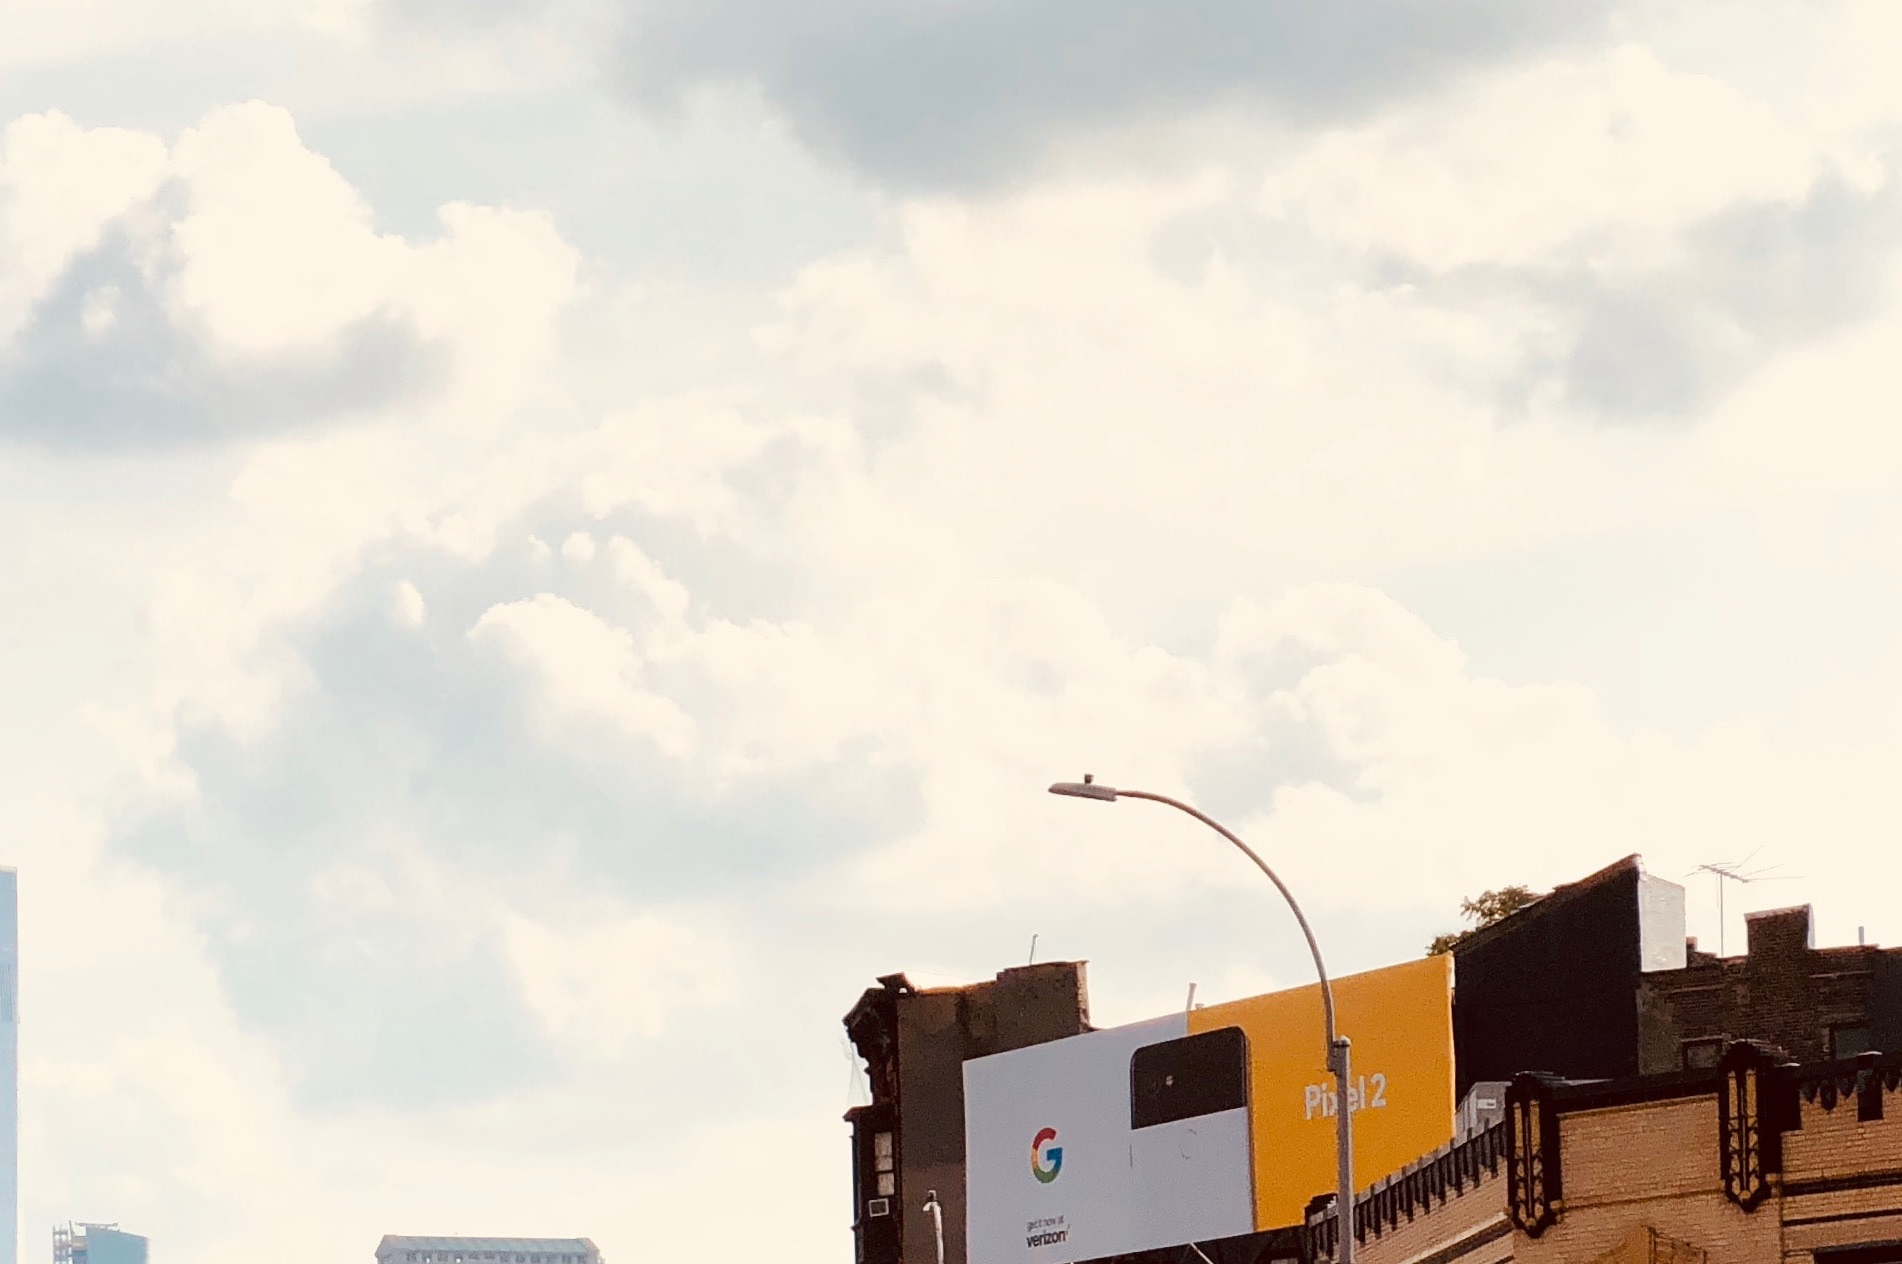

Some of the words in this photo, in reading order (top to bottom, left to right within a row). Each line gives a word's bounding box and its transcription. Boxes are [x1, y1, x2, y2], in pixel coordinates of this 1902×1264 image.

[1304, 1075, 1366, 1120] Pixel
[1370, 1072, 1387, 1108] 2
[1026, 1229, 1066, 1248] verizon
